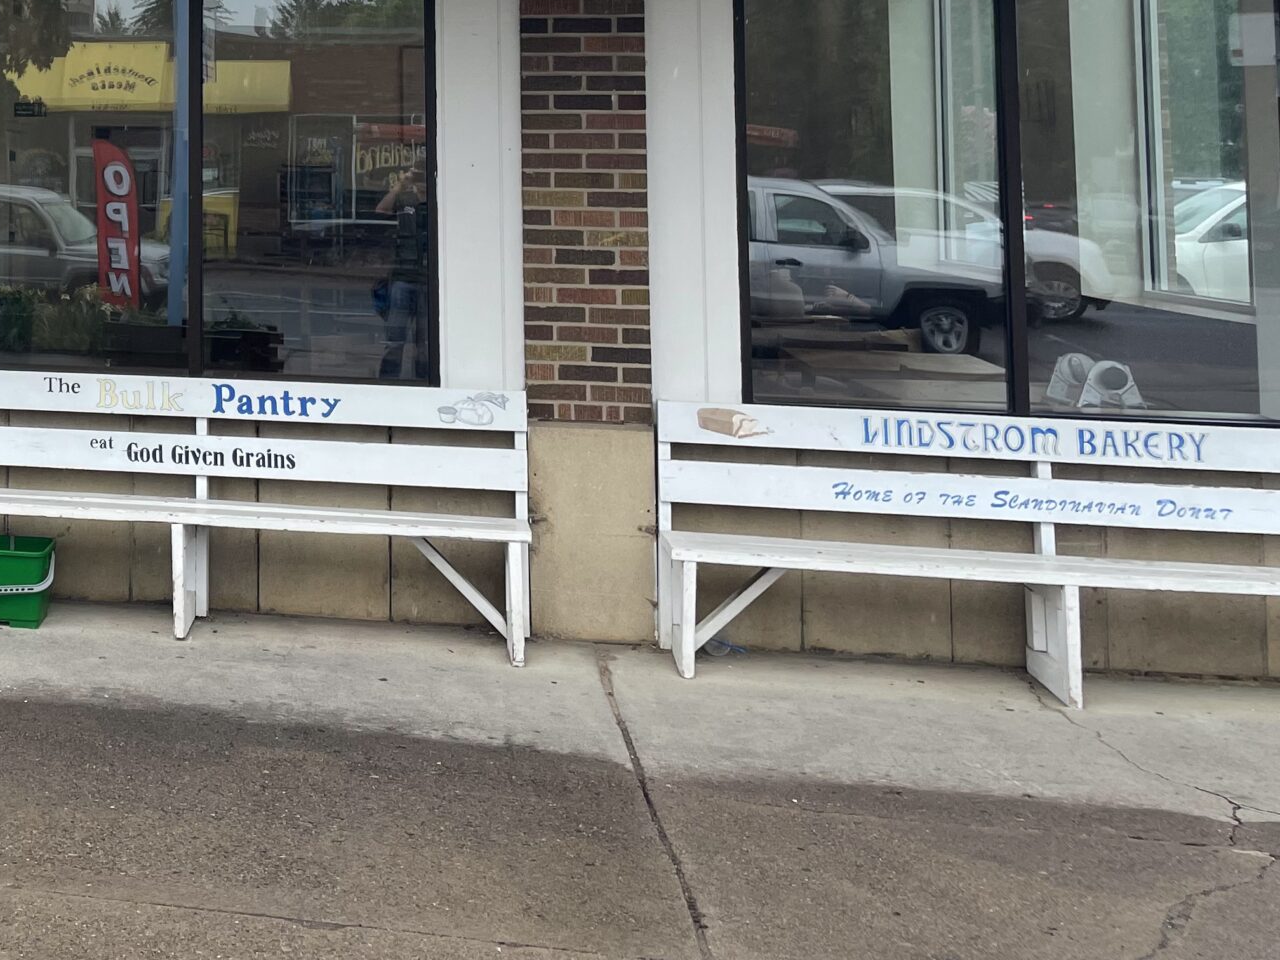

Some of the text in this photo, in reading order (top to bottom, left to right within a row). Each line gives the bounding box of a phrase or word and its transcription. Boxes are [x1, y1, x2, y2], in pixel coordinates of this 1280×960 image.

[44, 376, 341, 417] The Bulk Pantry
[89, 436, 296, 469] eat God Given Grains
[861, 415, 1210, 463] LINDSTROM BAKERY
